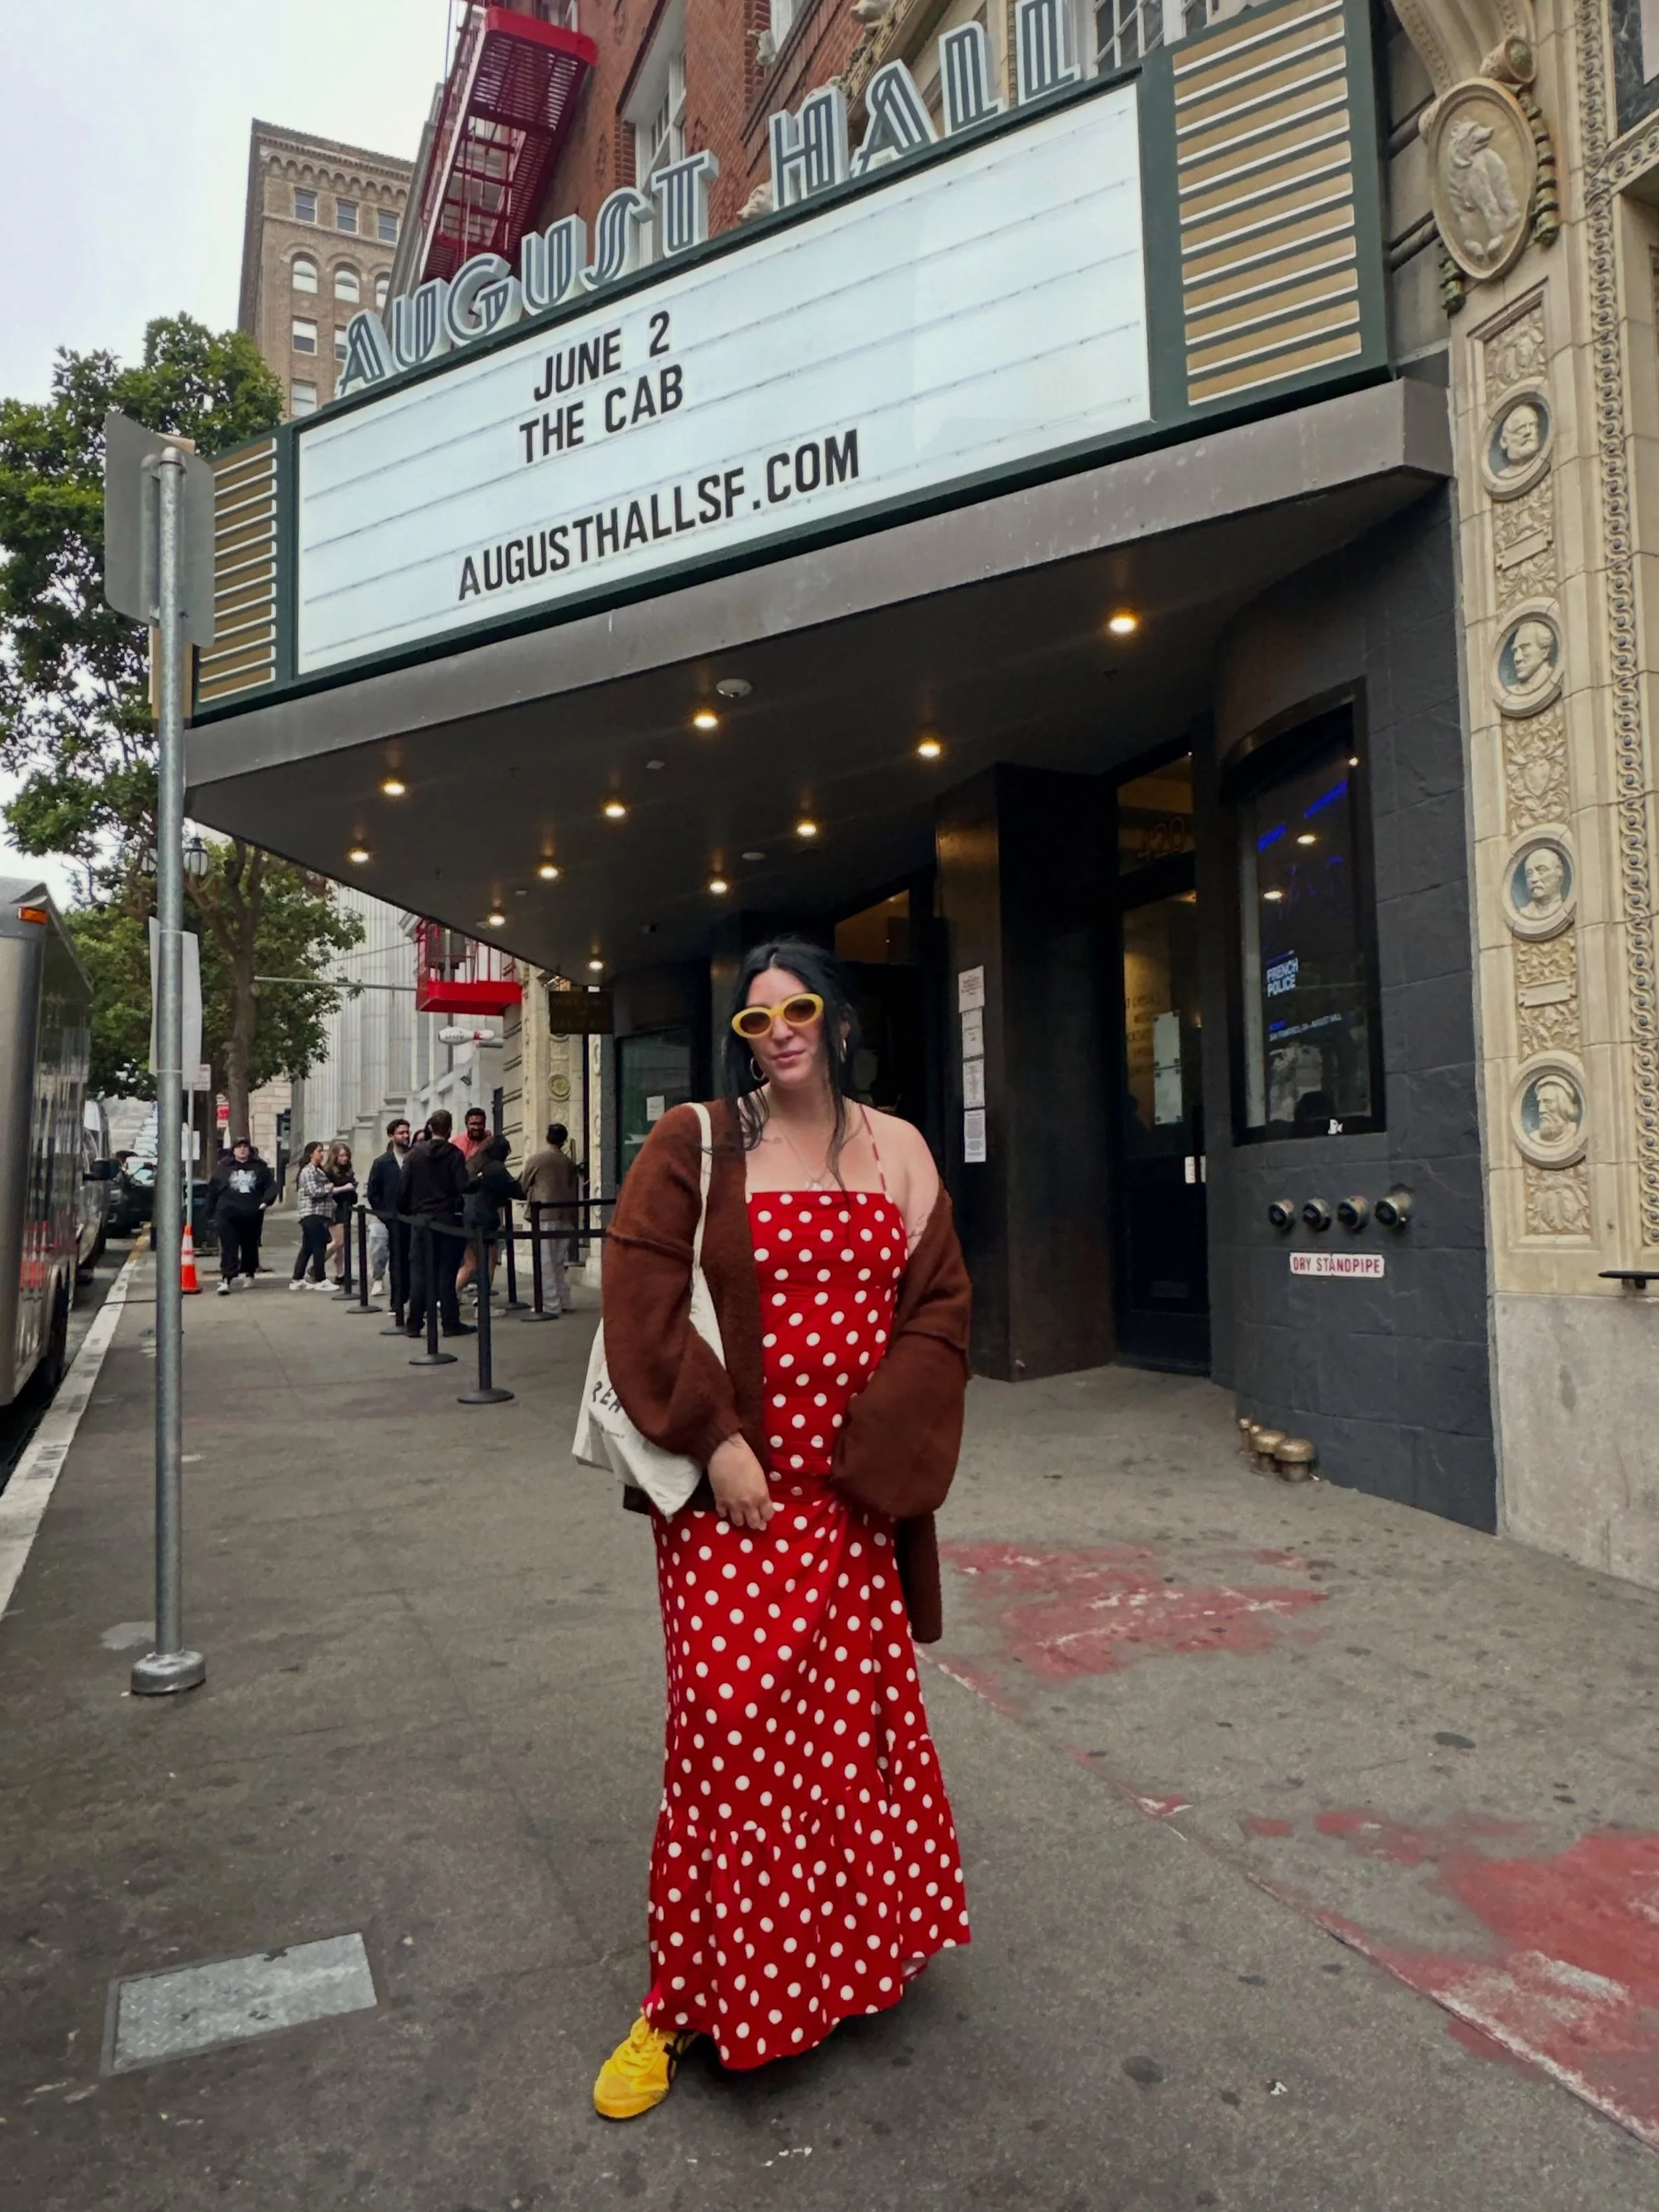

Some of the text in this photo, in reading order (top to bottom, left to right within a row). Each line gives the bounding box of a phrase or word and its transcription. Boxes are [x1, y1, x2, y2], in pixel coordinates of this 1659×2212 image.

[335, 0, 1082, 398] AUGUST HALL
[533, 310, 670, 402] JUNE 2
[519, 364, 684, 463] THE CAB
[459, 429, 859, 601] AUGUSTHALLSF.COM
[1137, 816, 1185, 861] 420
[1267, 974, 1295, 997] POLICE
[1293, 1256, 1380, 1274] DRY STANDPIPE
